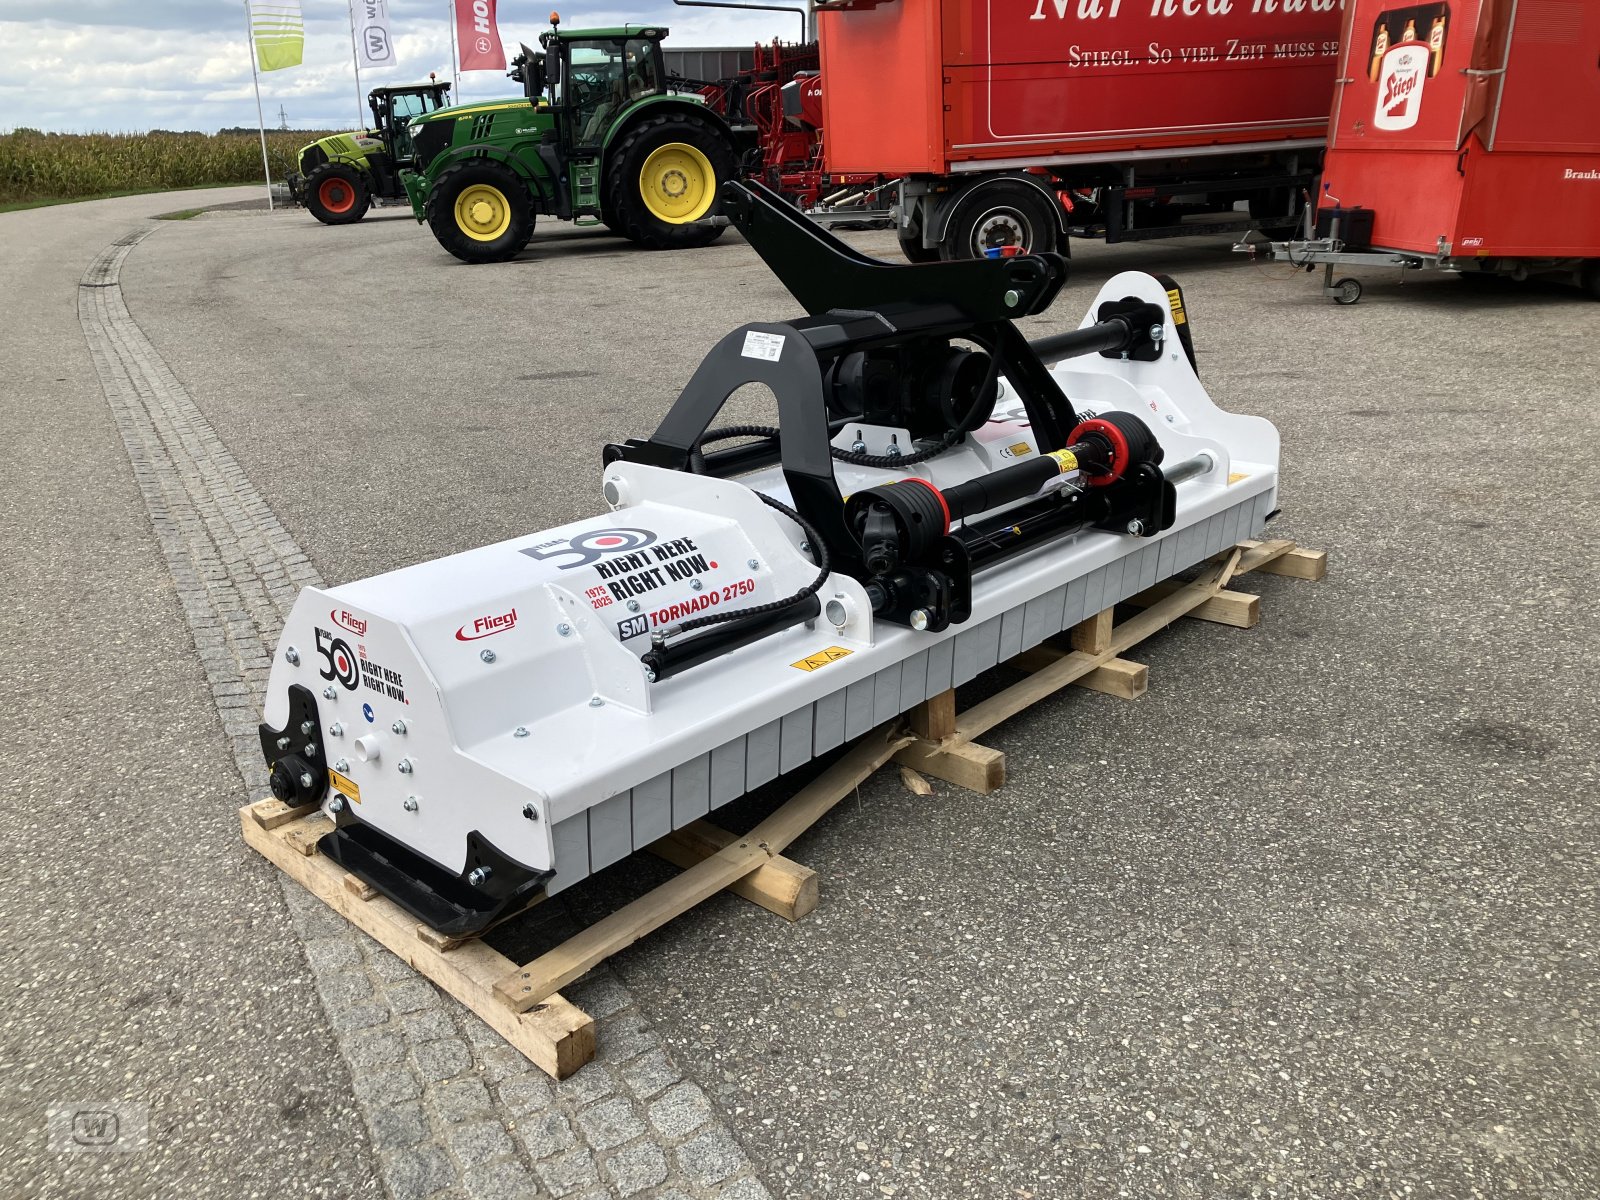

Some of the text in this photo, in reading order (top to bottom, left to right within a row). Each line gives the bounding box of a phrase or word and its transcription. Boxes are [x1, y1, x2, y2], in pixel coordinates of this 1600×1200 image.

[473, 0, 489, 34] HO
[1382, 70, 1419, 109] Stiegl
[1564, 168, 1600, 179] Brauk
[592, 536, 698, 580] RIGHT HERE
[584, 585, 607, 599] 1975
[606, 567, 666, 602] RIGHT
[591, 595, 613, 610] 2025
[620, 578, 755, 638] SM TORNADO 2750
[341, 610, 367, 635] Fliegl
[473, 607, 518, 634] Fliegl
[360, 658, 403, 688] RIGHT HERE
[362, 673, 385, 695] RIGHT
